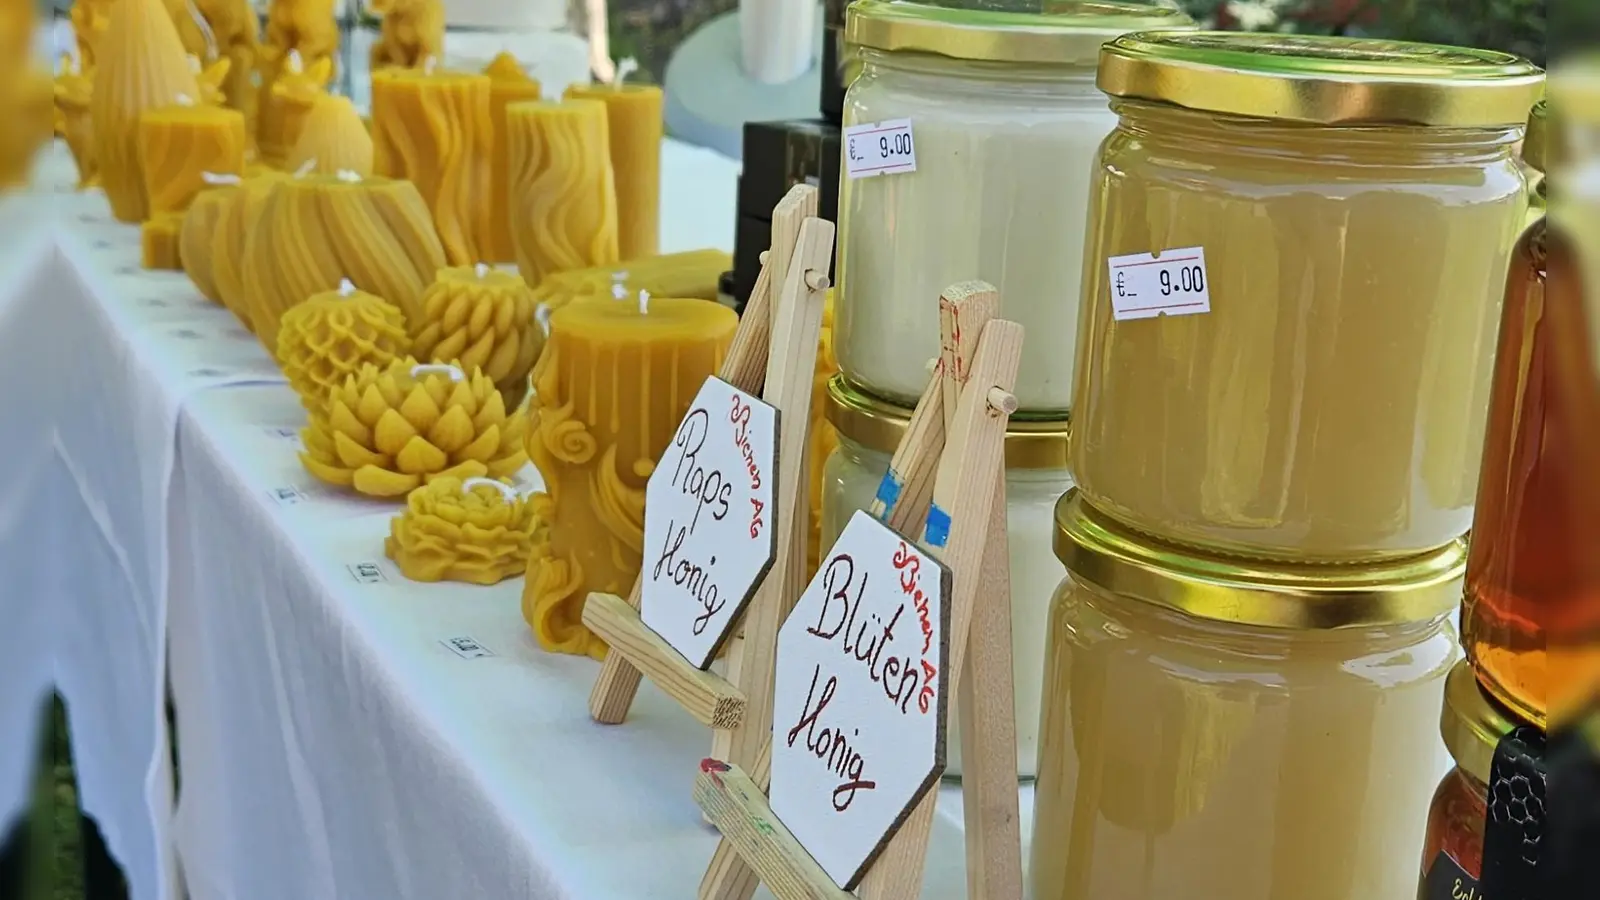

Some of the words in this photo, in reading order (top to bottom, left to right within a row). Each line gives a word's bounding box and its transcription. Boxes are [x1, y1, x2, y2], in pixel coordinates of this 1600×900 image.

[879, 132, 912, 158] 9.00
[1160, 265, 1204, 296] 9.00
[672, 408, 731, 535] Raps
[730, 394, 761, 490] Bienen
[749, 497, 764, 538] AG
[653, 519, 726, 635] Honig
[807, 553, 918, 714] Blüten
[893, 541, 933, 655] Bienen
[918, 658, 937, 715] AG
[787, 664, 876, 812] Honig
